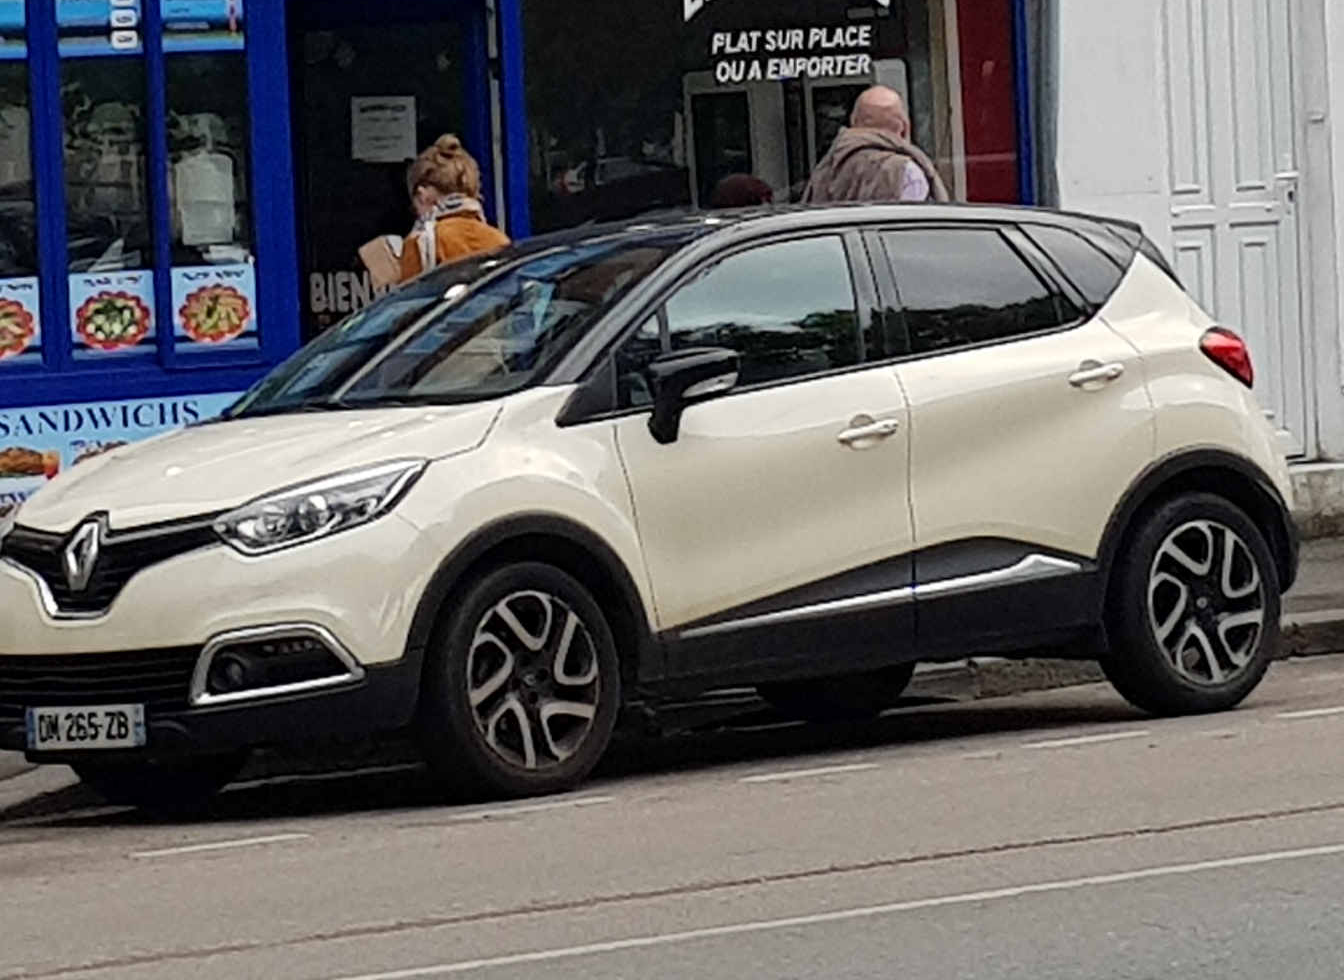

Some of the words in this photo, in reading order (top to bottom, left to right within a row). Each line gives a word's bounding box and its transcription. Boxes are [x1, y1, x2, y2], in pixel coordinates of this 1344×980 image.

[711, 30, 762, 55] PLAT
[764, 28, 804, 52] SUR
[807, 24, 872, 50] PLACE
[715, 59, 746, 83] OU
[747, 59, 763, 81] A
[765, 53, 871, 81] EMPORTER
